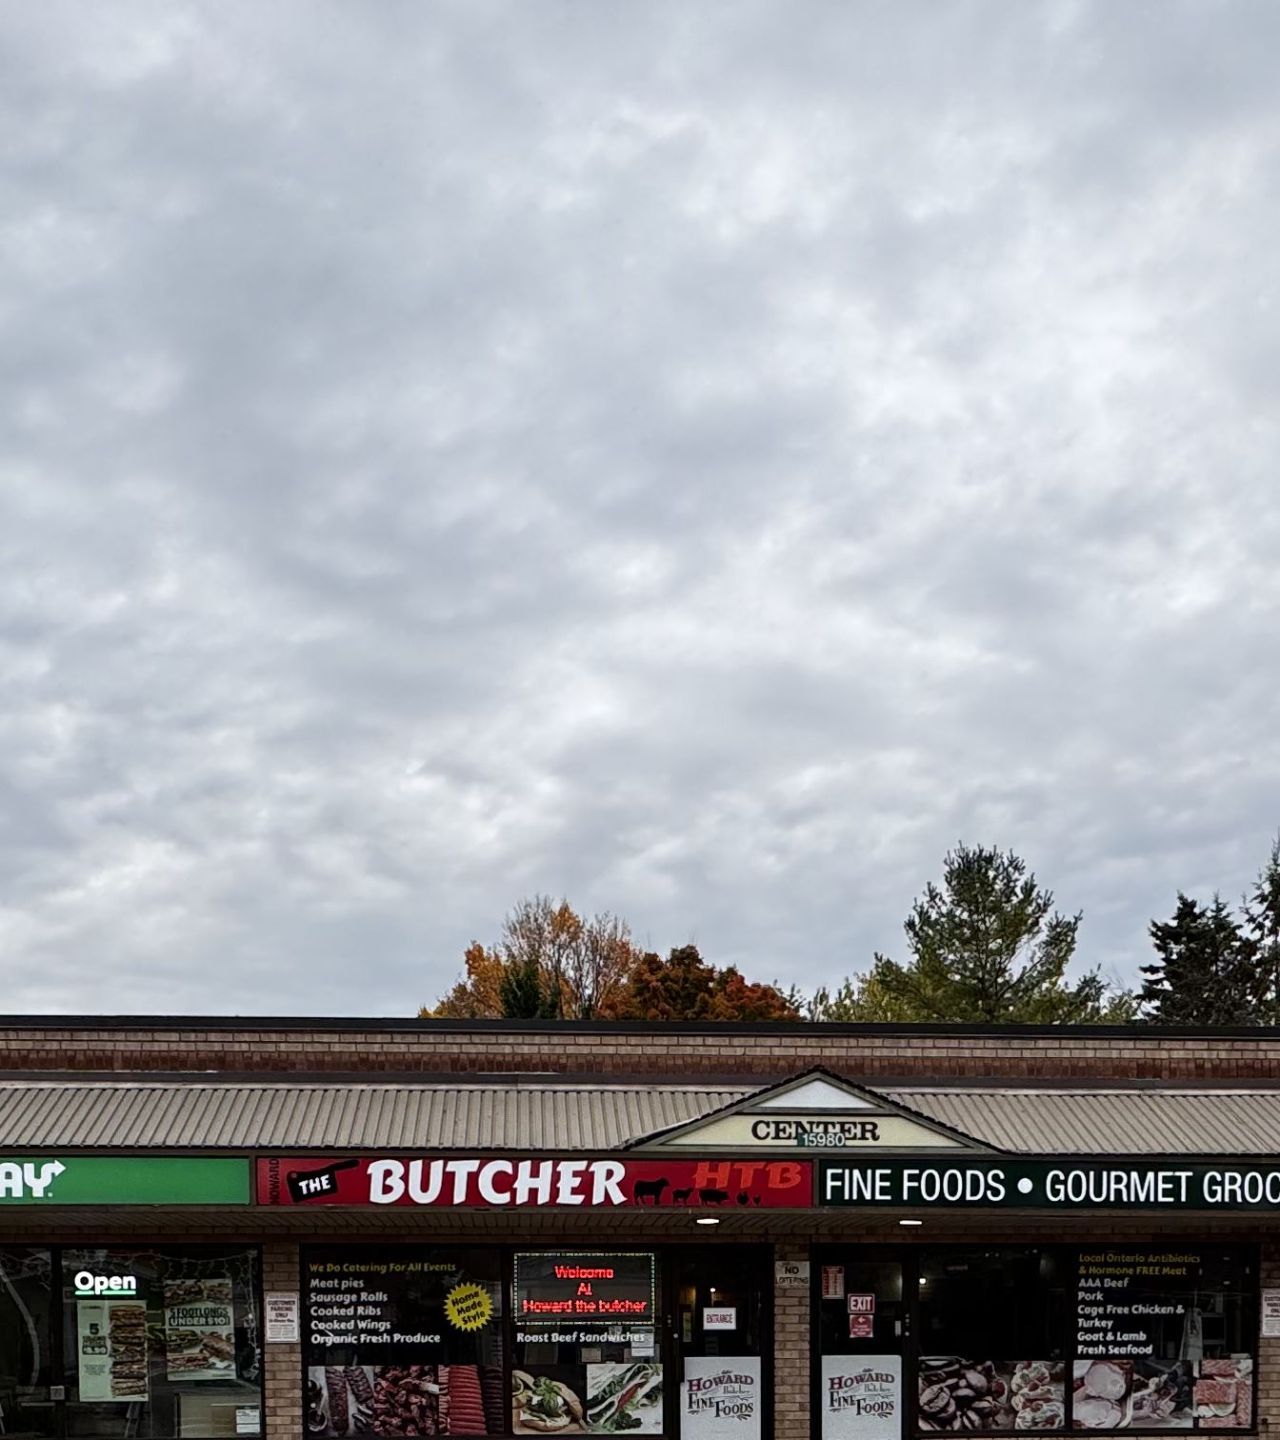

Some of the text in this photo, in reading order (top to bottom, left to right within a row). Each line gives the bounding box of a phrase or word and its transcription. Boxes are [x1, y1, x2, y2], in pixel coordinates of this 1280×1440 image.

[751, 1120, 880, 1141] CENTER
[802, 1133, 846, 1147] 15980
[693, 1161, 802, 1189] HTB
[298, 1159, 628, 1206] THE BUTCHER
[825, 1168, 892, 1200] FINE
[903, 1169, 1006, 1201] FOODS
[1045, 1169, 1193, 1202] GOURMET
[1079, 1253, 1200, 1263] Local Ontario Antibiotics
[309, 1262, 456, 1275] We Do Catering For All Events
[554, 1265, 615, 1279] Welcome
[785, 1266, 800, 1275] NO
[1089, 1266, 1134, 1275] Hormone
[1136, 1266, 1160, 1275] FREE
[1162, 1266, 1187, 1275] Meat
[74, 1270, 137, 1296] Open
[310, 1278, 365, 1291] Meat pies
[1078, 1277, 1130, 1288] AAA Beef
[310, 1291, 389, 1305] Sausage Rolls
[451, 1291, 480, 1307] Home
[1077, 1291, 1104, 1301] Pork
[457, 1300, 483, 1316] Made
[522, 1299, 648, 1313] Howard the butcher
[850, 1296, 873, 1311] EXIT
[1077, 1303, 1185, 1317] Cage Free Chicken &
[310, 1306, 382, 1316] Cooked Ribs
[462, 1311, 486, 1326] Style
[1077, 1318, 1114, 1330] Turkey
[89, 1323, 100, 1335] 5
[310, 1320, 392, 1332] Cooked Wings
[311, 1333, 441, 1347] Organic Fresh Produce
[516, 1331, 646, 1343] Roast Beef Sandwiches
[1077, 1330, 1147, 1341] Goat & Lamb
[1077, 1343, 1153, 1355] Fresh Seafood
[687, 1374, 755, 1393] HOWARD
[828, 1372, 895, 1391] HOWARD
[687, 1392, 755, 1419] FINE FOODS
[829, 1390, 895, 1416] FINE FOODS
